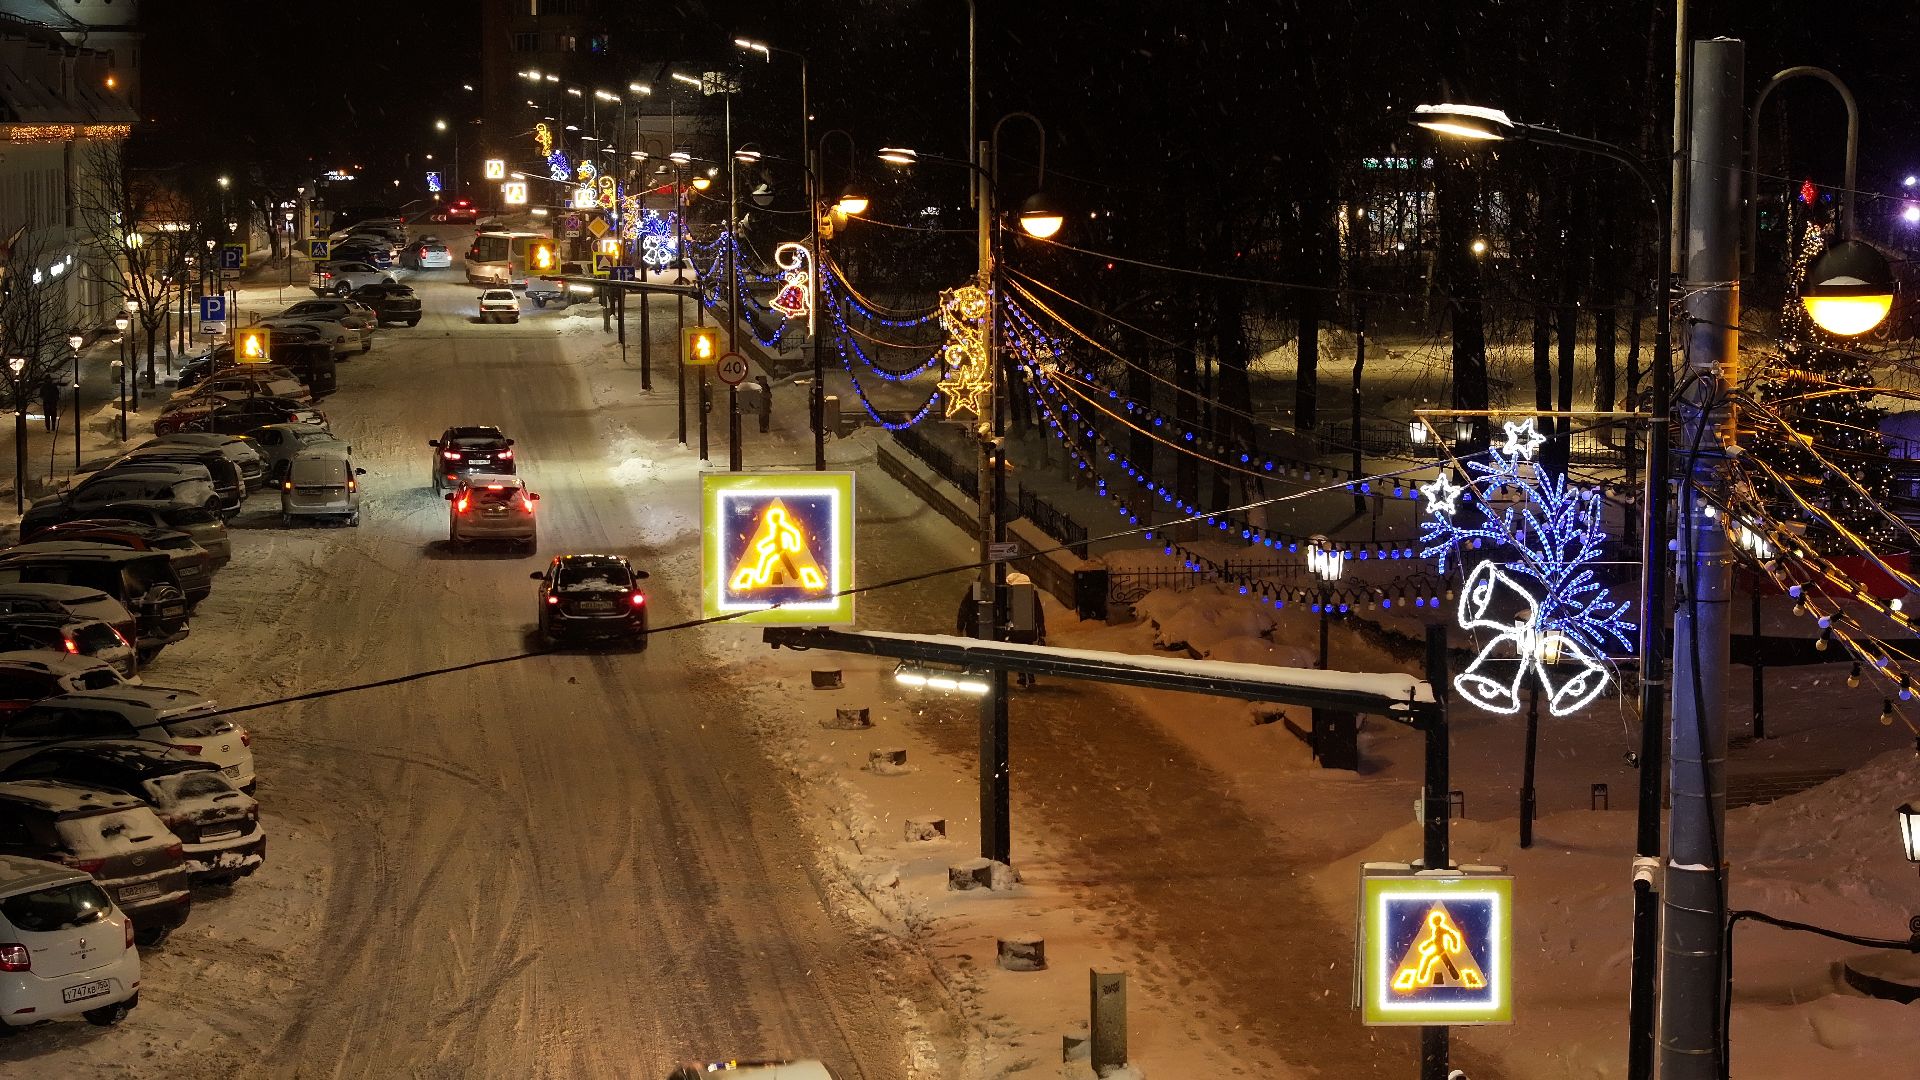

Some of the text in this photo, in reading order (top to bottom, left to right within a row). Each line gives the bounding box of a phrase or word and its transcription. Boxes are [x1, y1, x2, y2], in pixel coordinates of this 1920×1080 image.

[226, 251, 237, 267] P
[207, 299, 221, 319] P
[723, 361, 742, 374] 40
